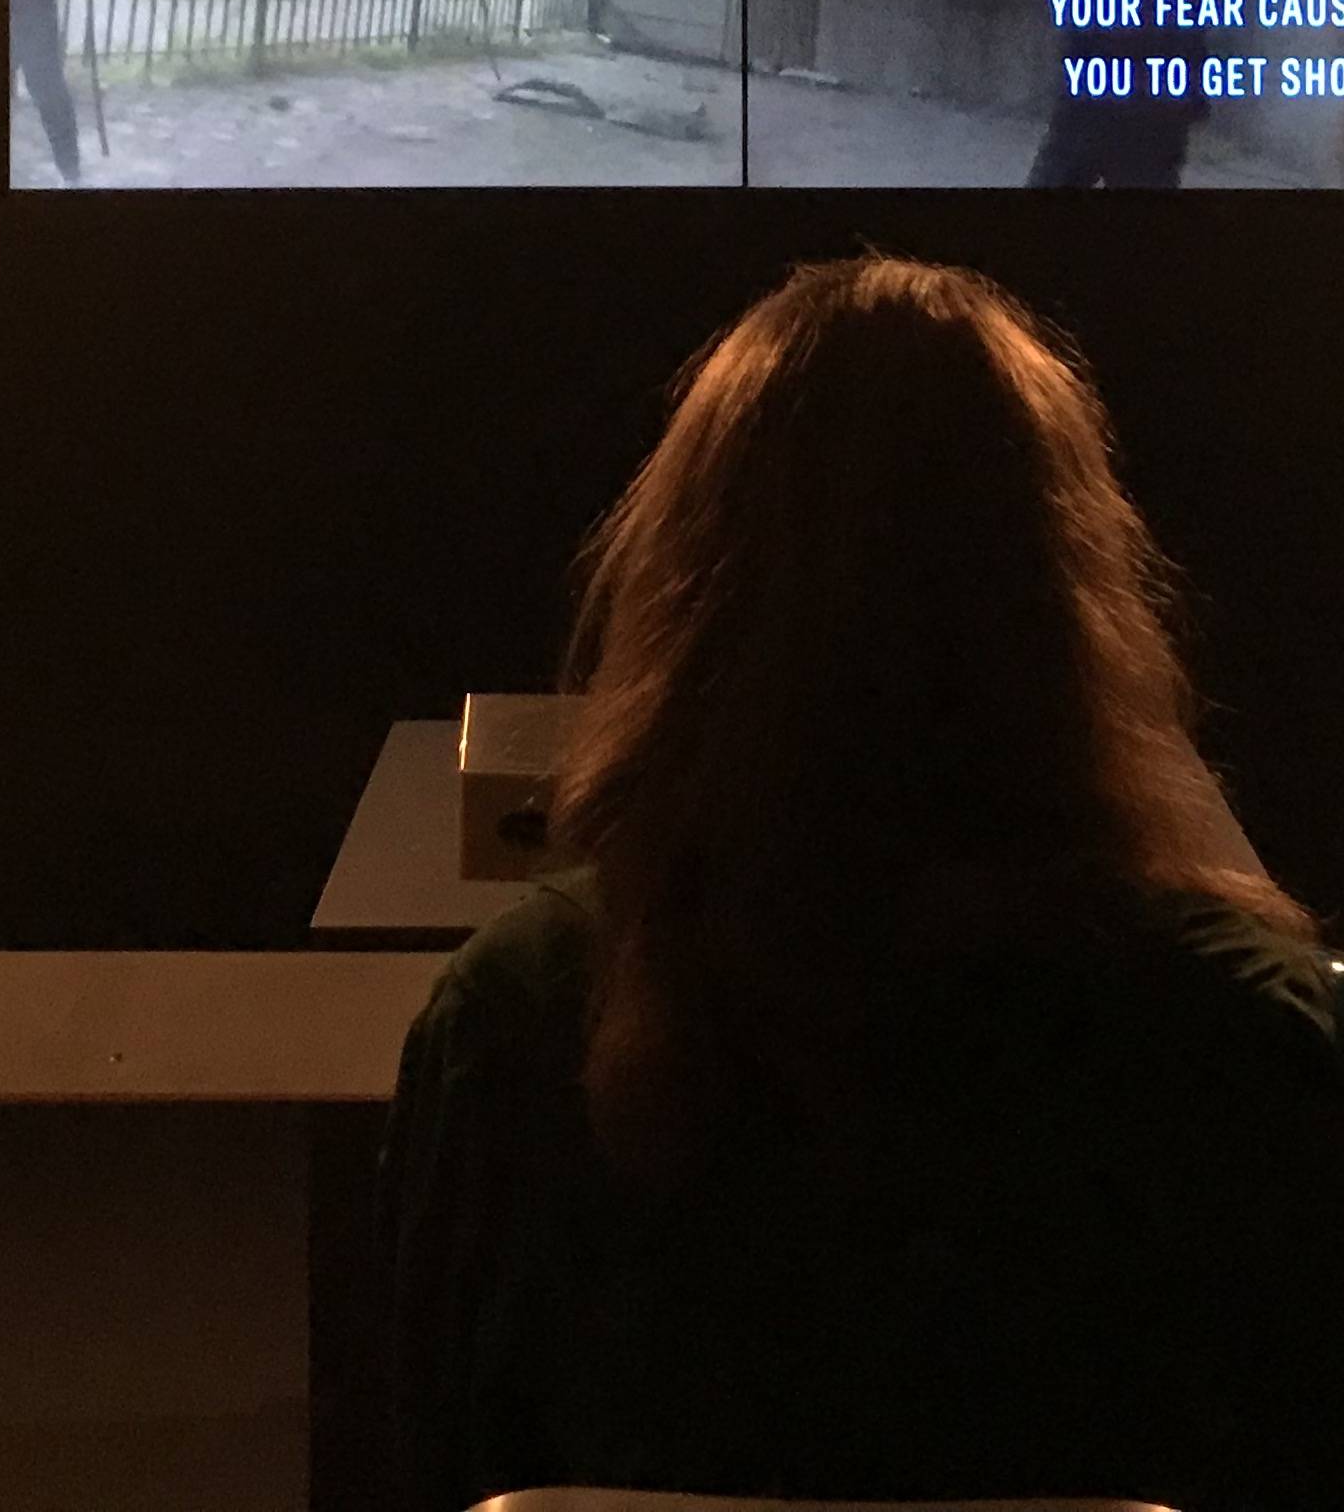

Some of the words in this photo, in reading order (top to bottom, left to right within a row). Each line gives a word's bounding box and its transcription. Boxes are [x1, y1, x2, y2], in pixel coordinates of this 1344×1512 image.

[1064, 57, 1131, 96] YOU
[1146, 57, 1187, 96] TO
[1202, 57, 1267, 96] GET
